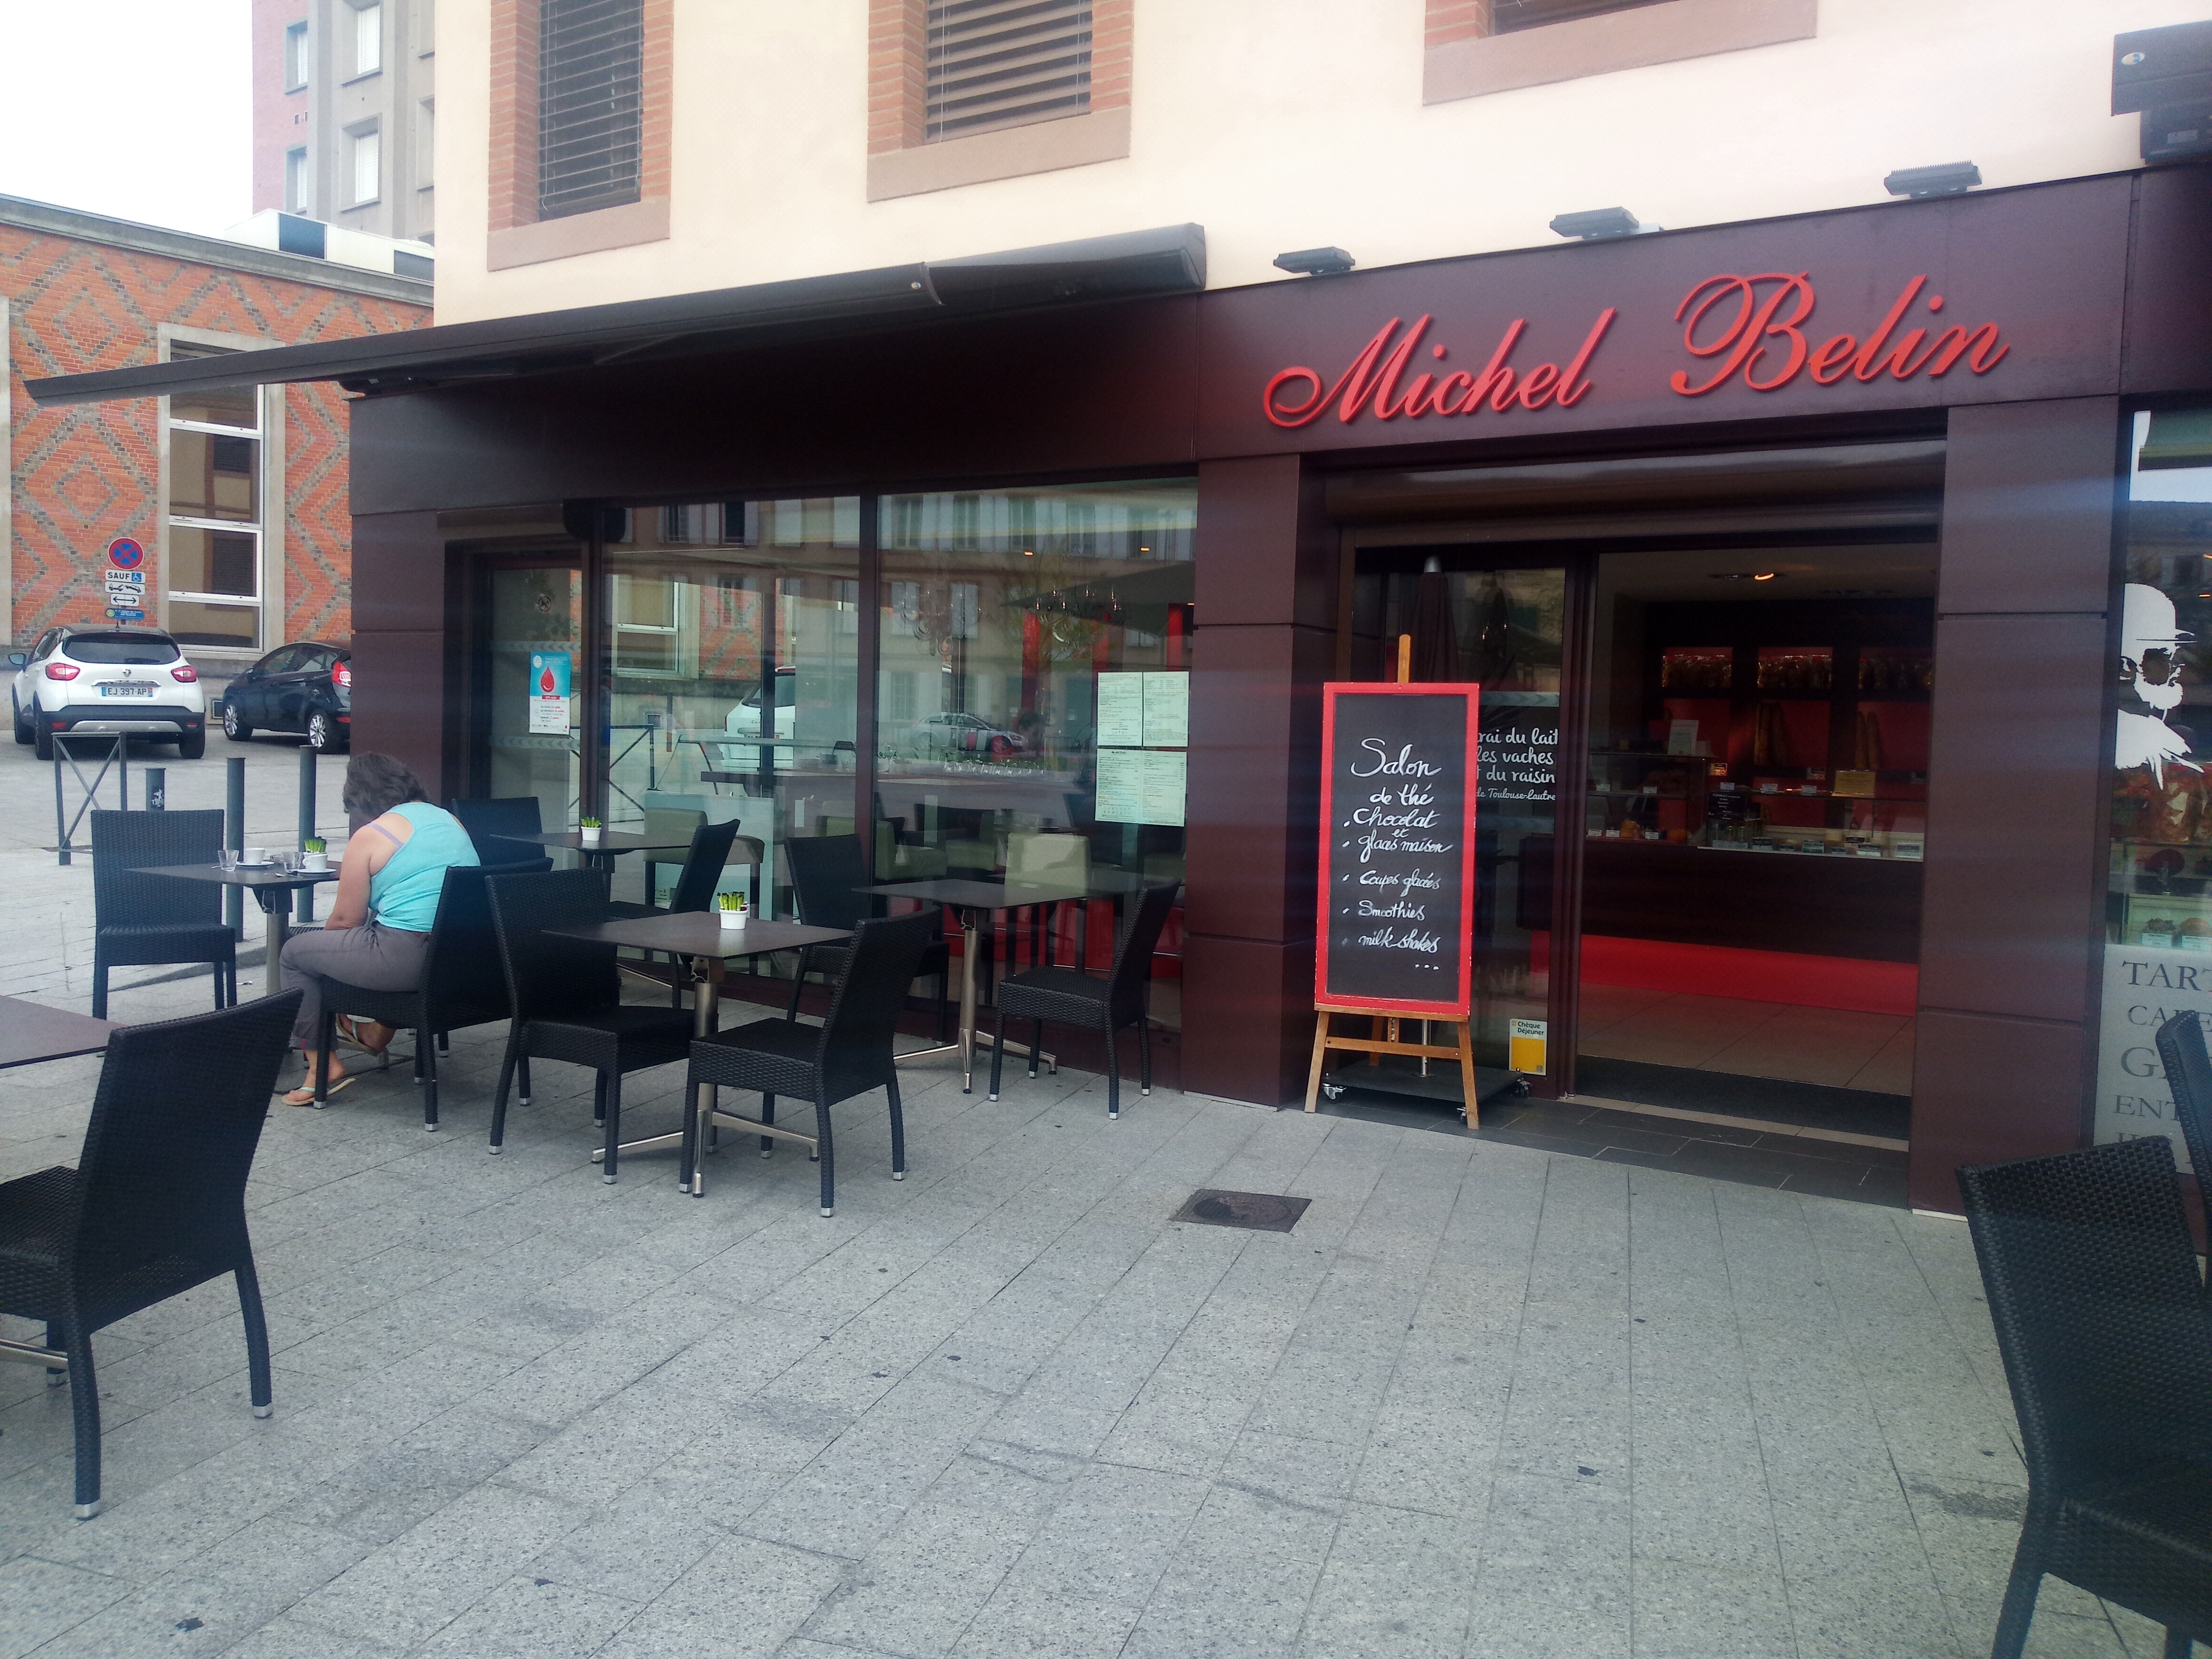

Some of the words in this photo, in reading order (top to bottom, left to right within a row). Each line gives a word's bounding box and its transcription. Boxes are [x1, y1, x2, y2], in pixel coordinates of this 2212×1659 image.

[1263, 307, 1617, 429] Michel
[1670, 271, 2010, 396] Belin
[1505, 727, 1527, 744] du
[1531, 728, 1558, 745] lait
[1351, 738, 1442, 778] Salon
[1502, 746, 1554, 765] vaches
[1486, 764, 1507, 781] du
[1511, 768, 1555, 783] raisin
[1370, 786, 1392, 805] de
[1397, 783, 1434, 805] thé
[1353, 806, 1441, 829] Chocolat
[1391, 828, 1410, 838] et
[1400, 837, 1454, 853] maison
[1359, 870, 1401, 893] Coupes
[1358, 899, 1425, 921] Smoothies
[2122, 961, 2212, 992] TAR
[1517, 1021, 1540, 1029] Chèque
